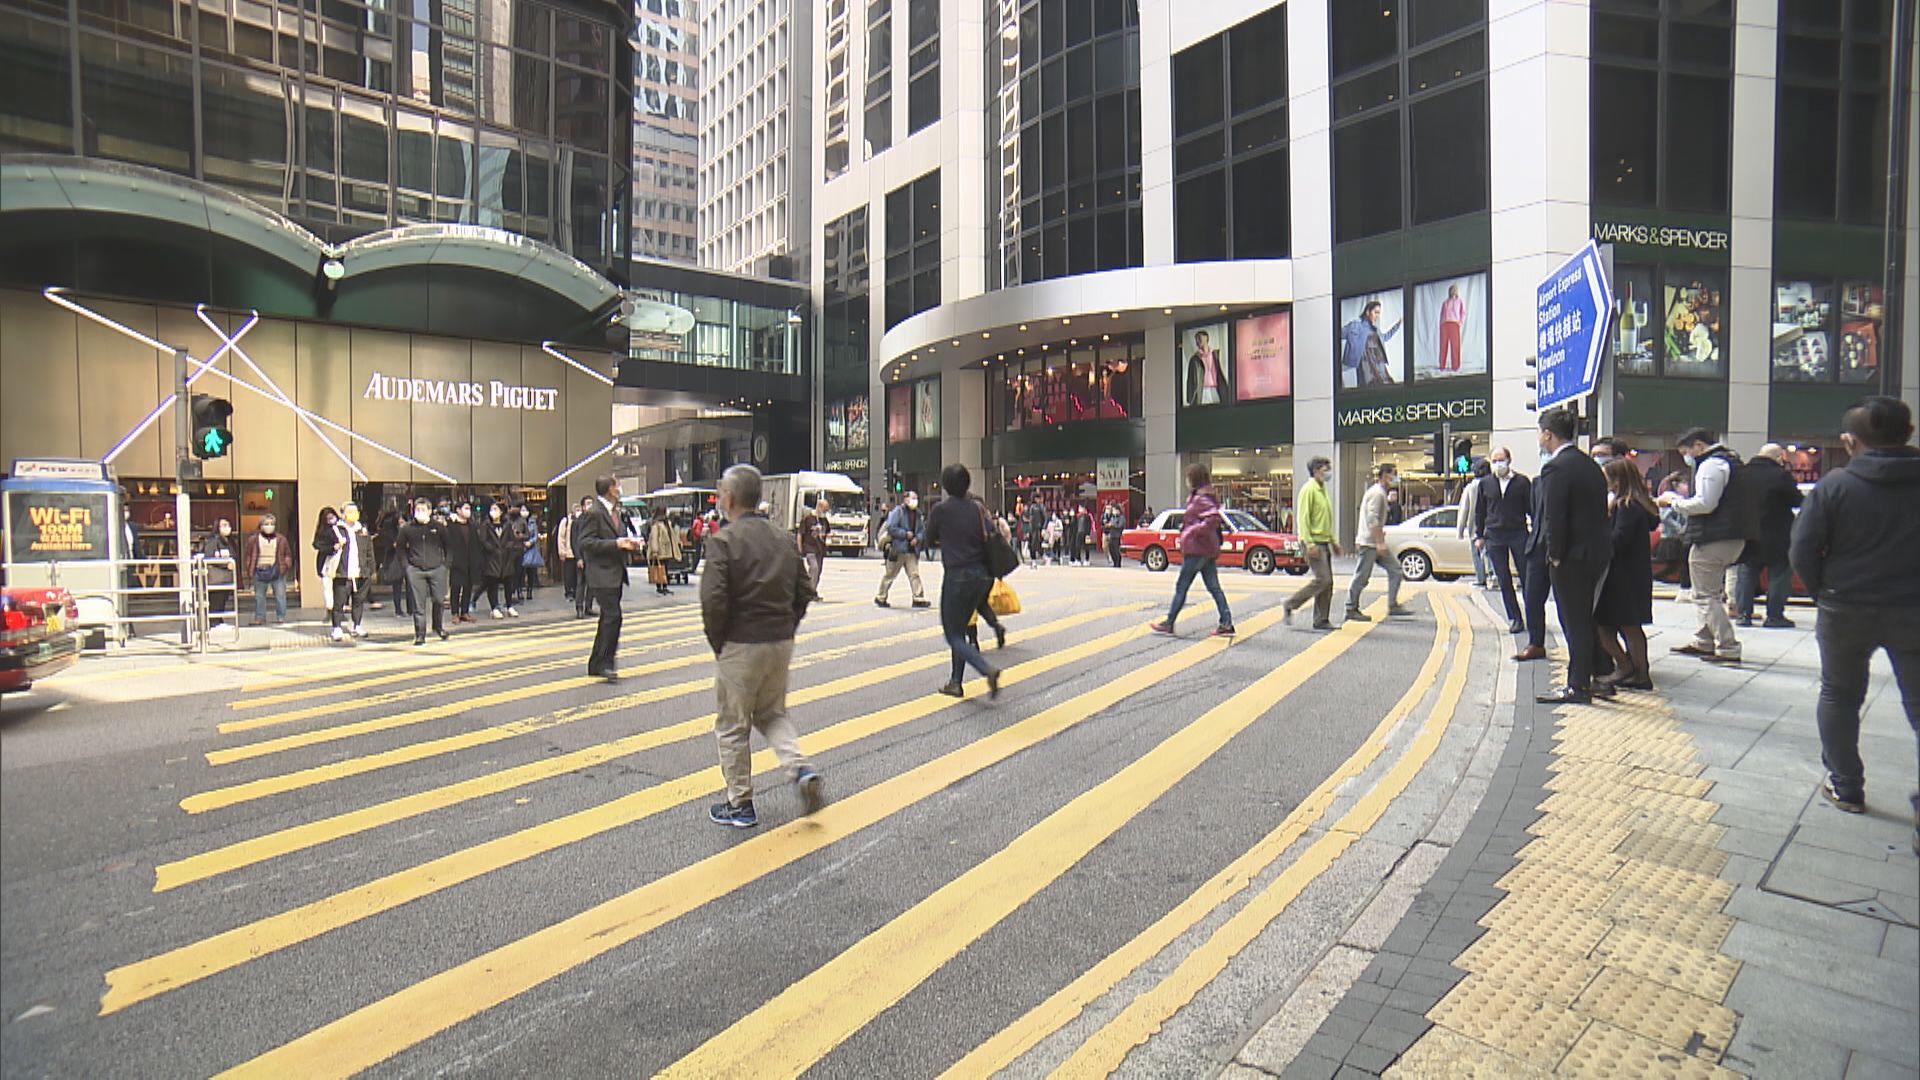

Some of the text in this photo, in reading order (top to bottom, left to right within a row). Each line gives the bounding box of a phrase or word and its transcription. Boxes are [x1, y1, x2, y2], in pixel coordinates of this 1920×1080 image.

[1539, 267, 1582, 308] Airport Express
[1539, 303, 1561, 328] Station
[1539, 348, 1566, 372] Kowloon
[364, 372, 559, 410] AUDEMARS PIGUET
[1539, 372, 1555, 398] 九龍
[1338, 407, 1392, 427] MARKS
[1406, 399, 1487, 421] SPENCER
[1099, 469, 1127, 480] SALE
[29, 507, 91, 526] Wi-Fi
